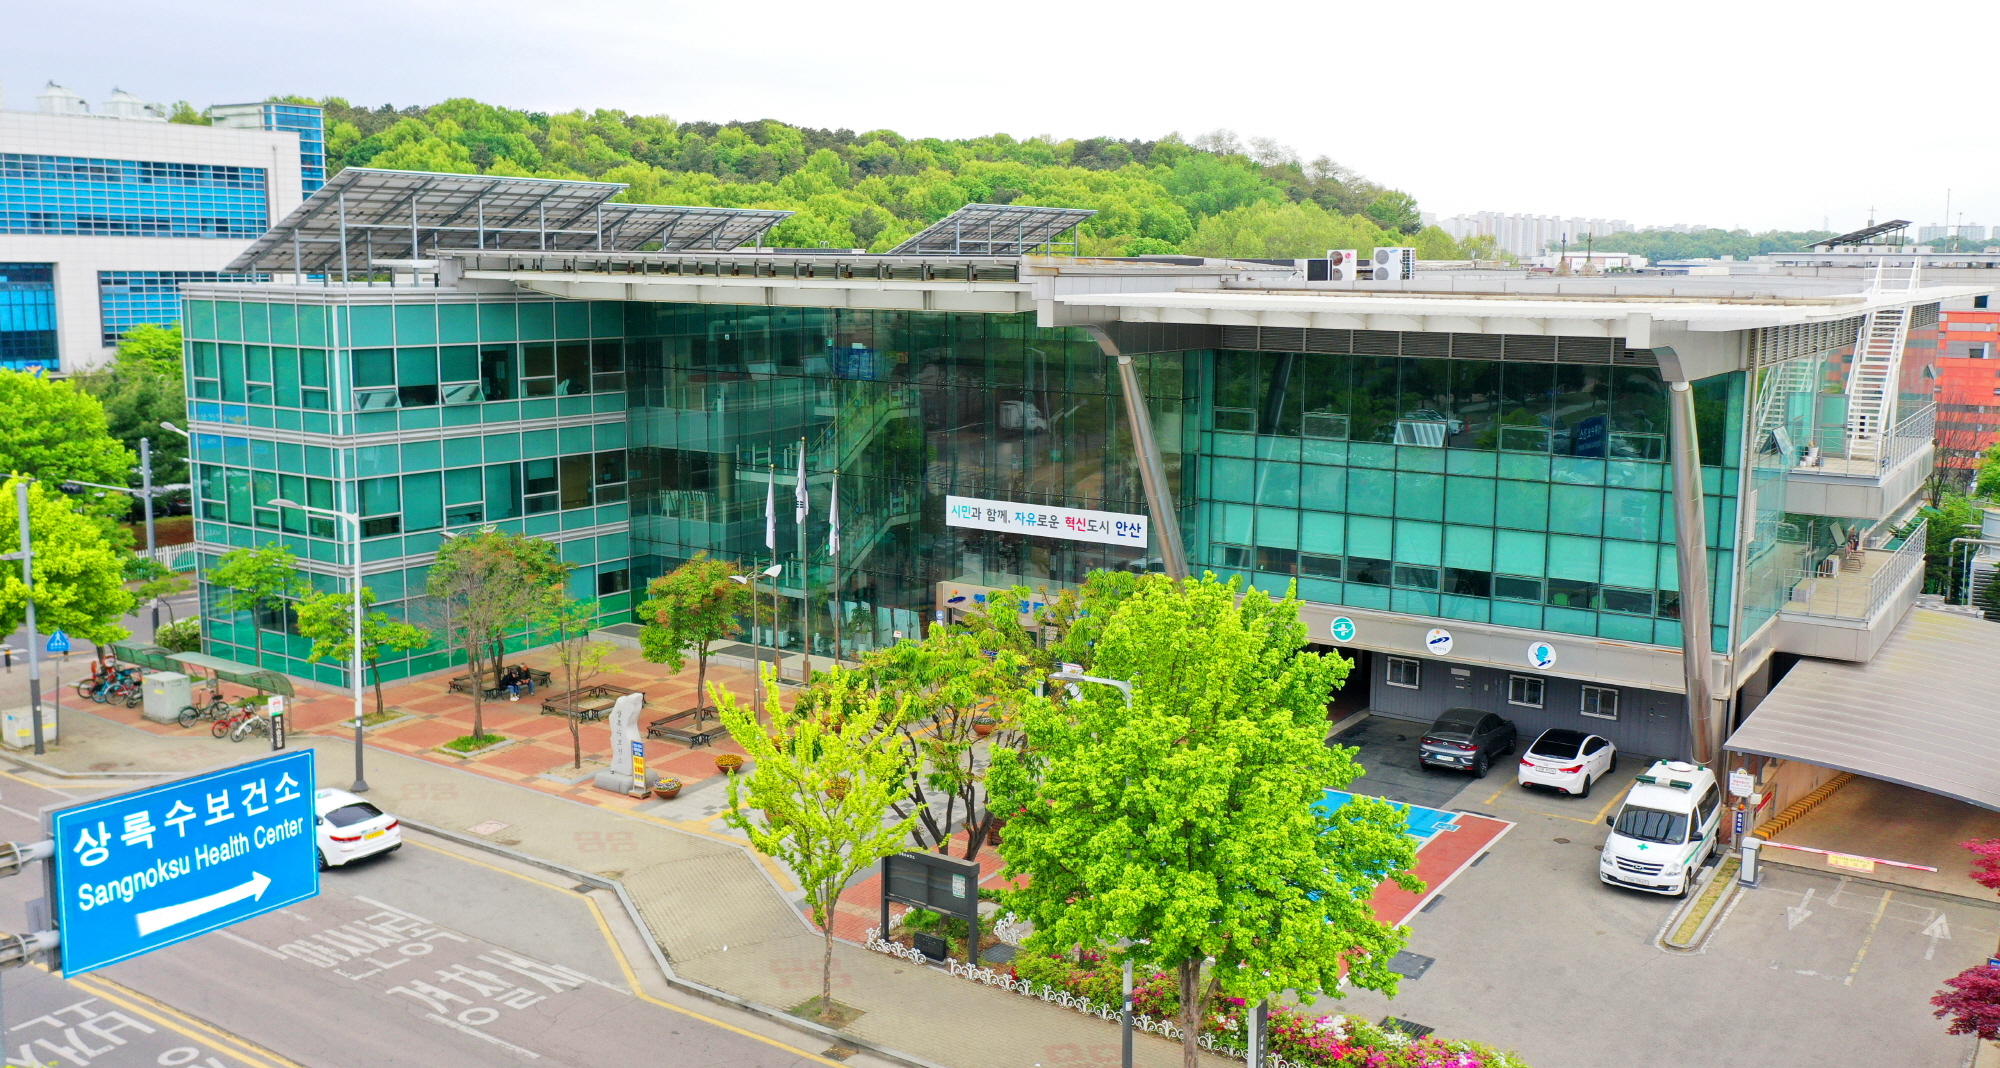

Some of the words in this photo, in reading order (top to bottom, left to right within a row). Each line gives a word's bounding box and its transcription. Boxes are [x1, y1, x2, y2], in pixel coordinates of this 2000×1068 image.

[951, 504, 982, 521] 시민과
[986, 507, 1011, 524] 함께,
[1014, 511, 1060, 529] 자유로운
[1064, 516, 1110, 535] 혁신도시
[1115, 520, 1142, 539] 안산
[73, 771, 300, 867] 상록수보건소
[78, 854, 191, 911] Sangnoksu
[195, 832, 250, 871] Health
[253, 816, 304, 850] Center
[277, 911, 468, 981] 안산상록
[385, 949, 586, 1026] 경찰서
